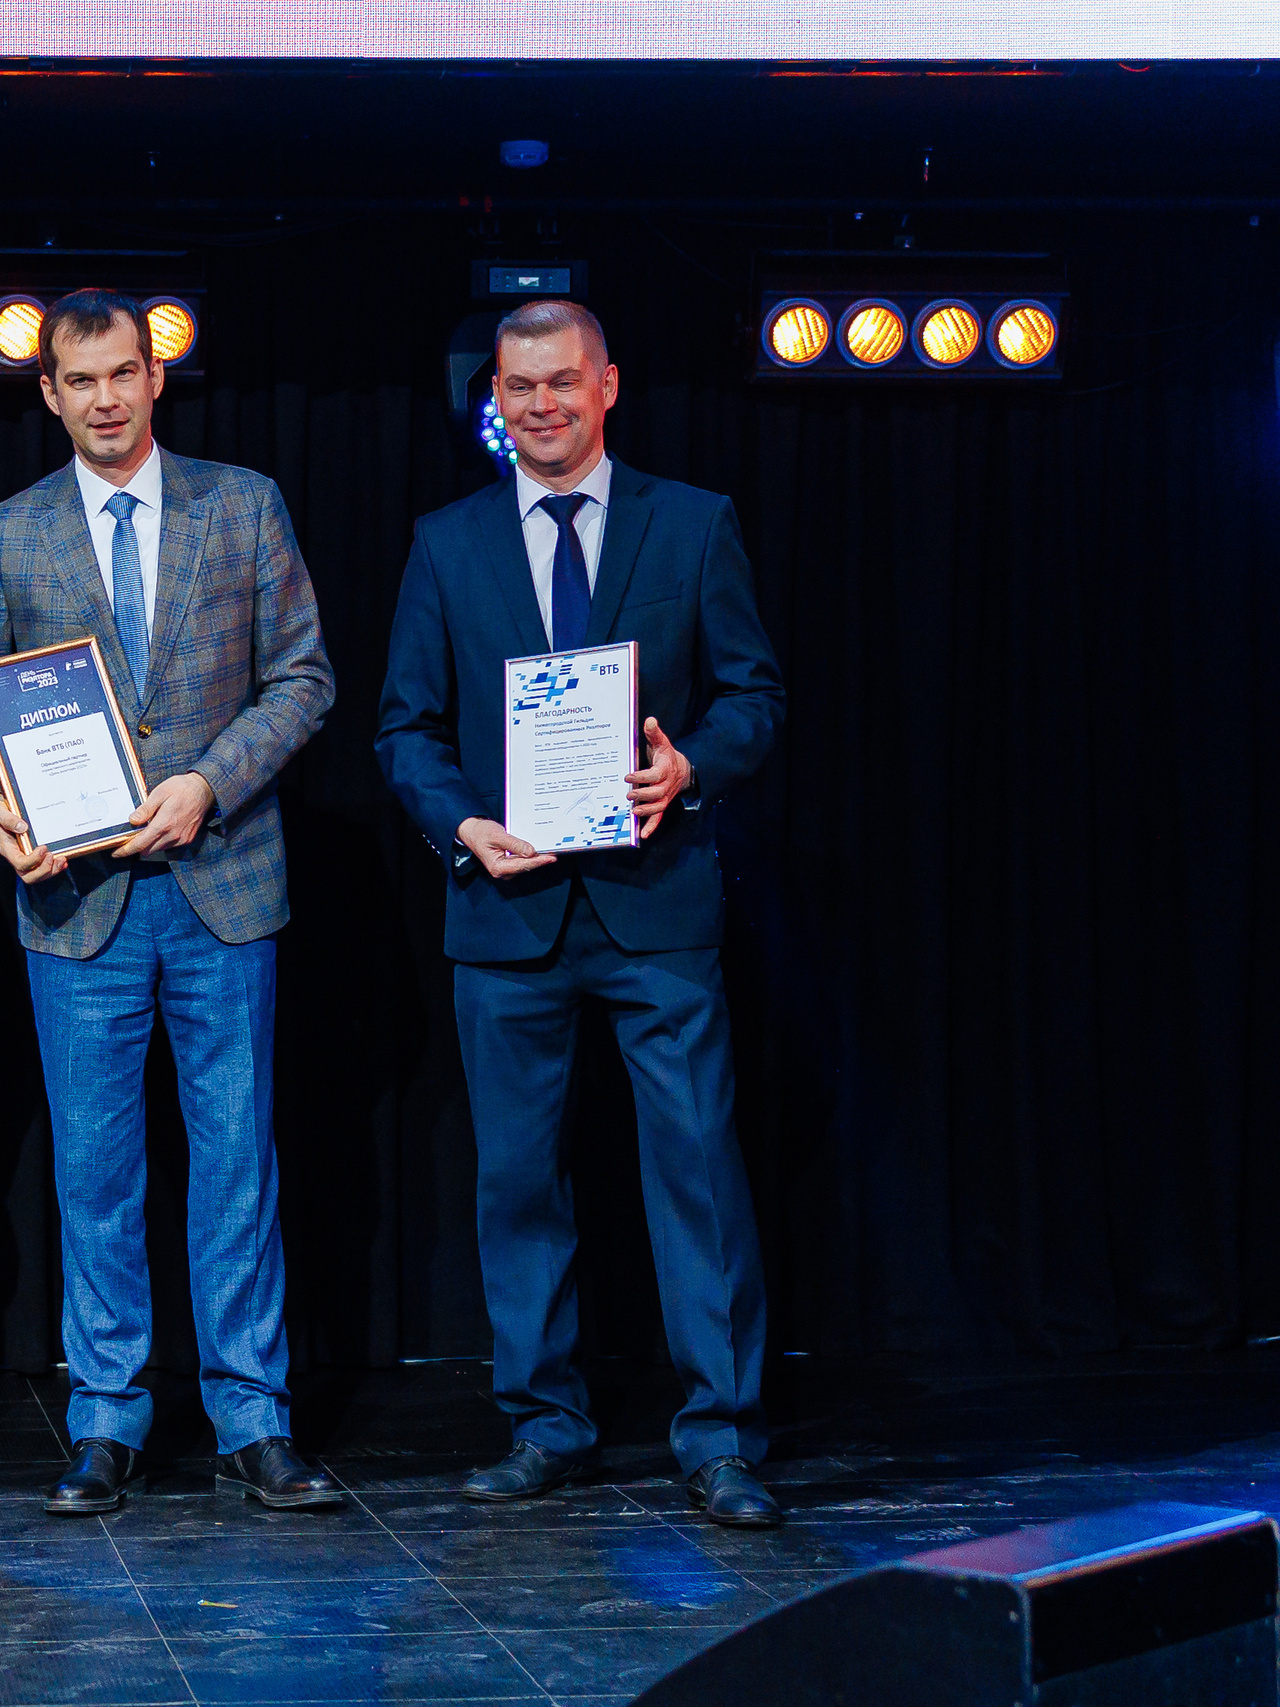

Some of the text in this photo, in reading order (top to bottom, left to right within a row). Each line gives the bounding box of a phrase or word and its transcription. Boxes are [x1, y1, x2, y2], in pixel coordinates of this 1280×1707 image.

[20, 670, 36, 679] ДЕНЬ
[599, 664, 620, 676] ВТБ
[37, 676, 59, 688] 2023
[20, 701, 81, 729] ДИПЛОМ
[534, 705, 593, 719] БЛАГОДАРНОСТЬ
[35, 738, 85, 756] Банк ВТБ (ПАО)
